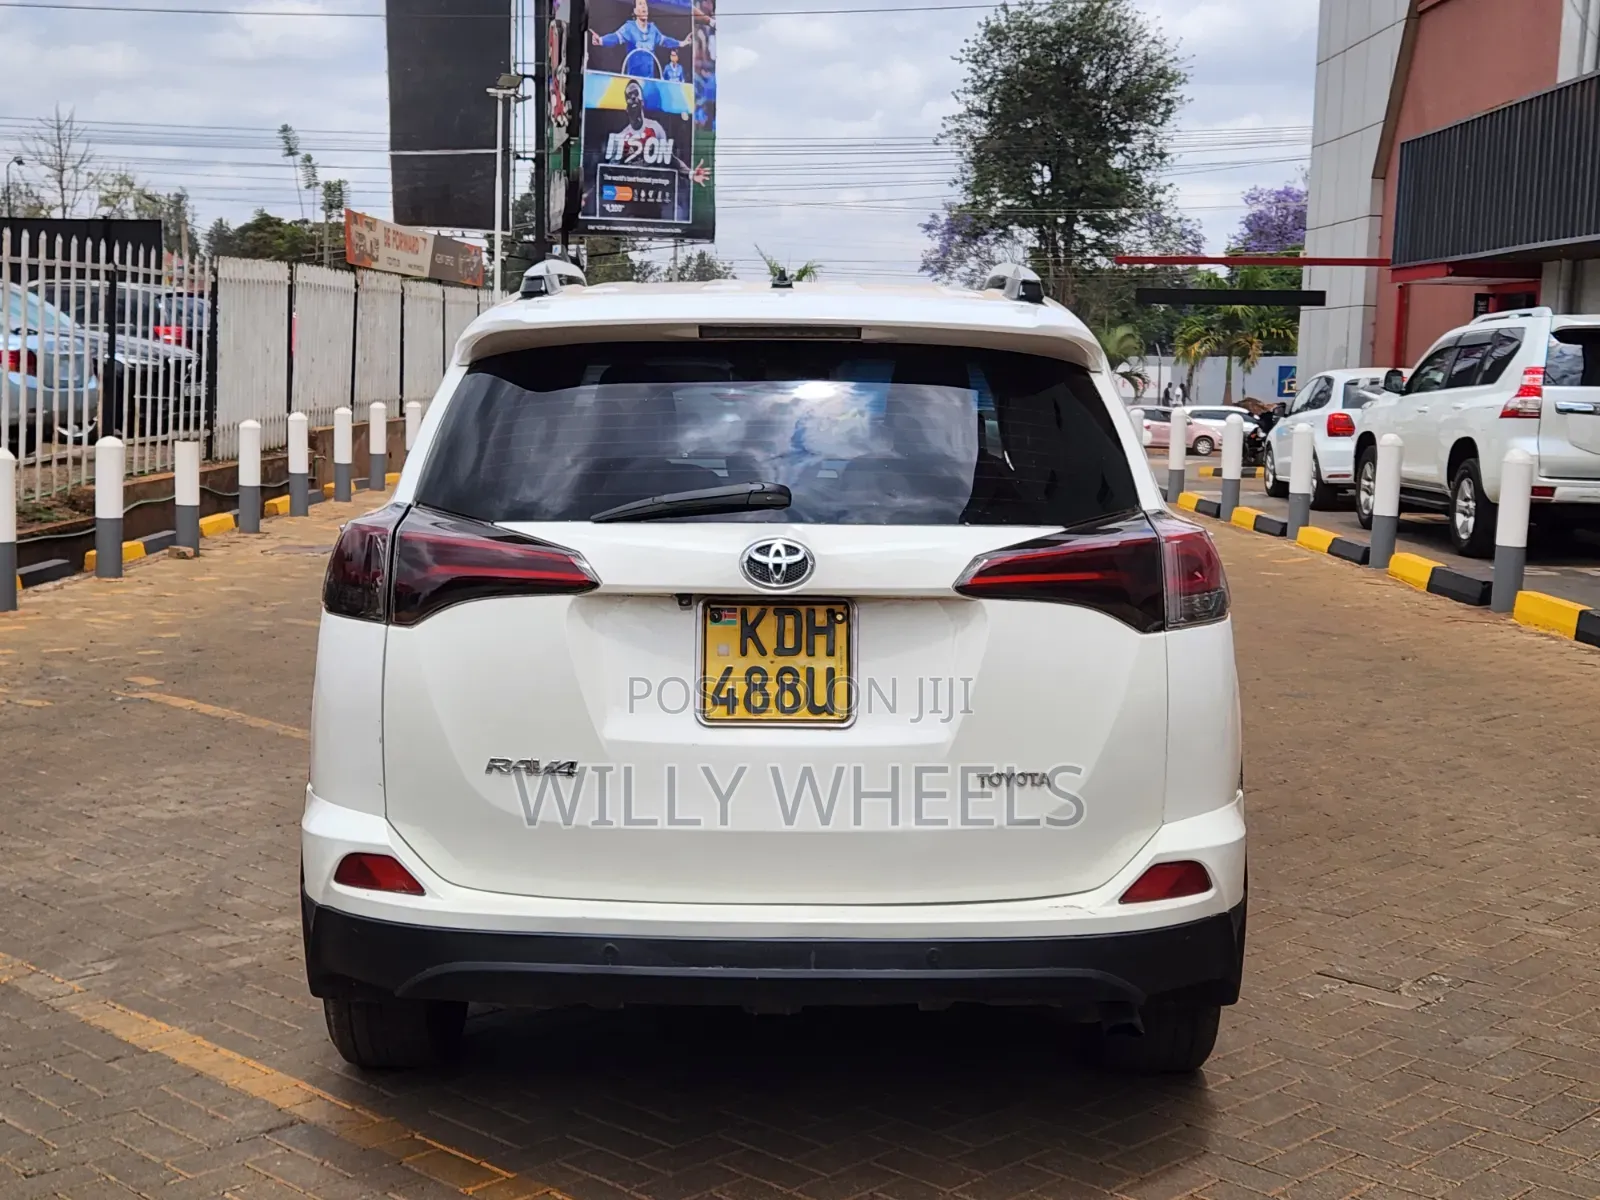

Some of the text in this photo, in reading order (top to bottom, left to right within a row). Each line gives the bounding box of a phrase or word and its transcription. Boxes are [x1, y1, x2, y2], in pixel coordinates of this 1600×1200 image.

[739, 607, 836, 657] KDH
[711, 666, 836, 715] 488U
[482, 755, 579, 778] RAV4
[976, 771, 1052, 789] TOYOTA
